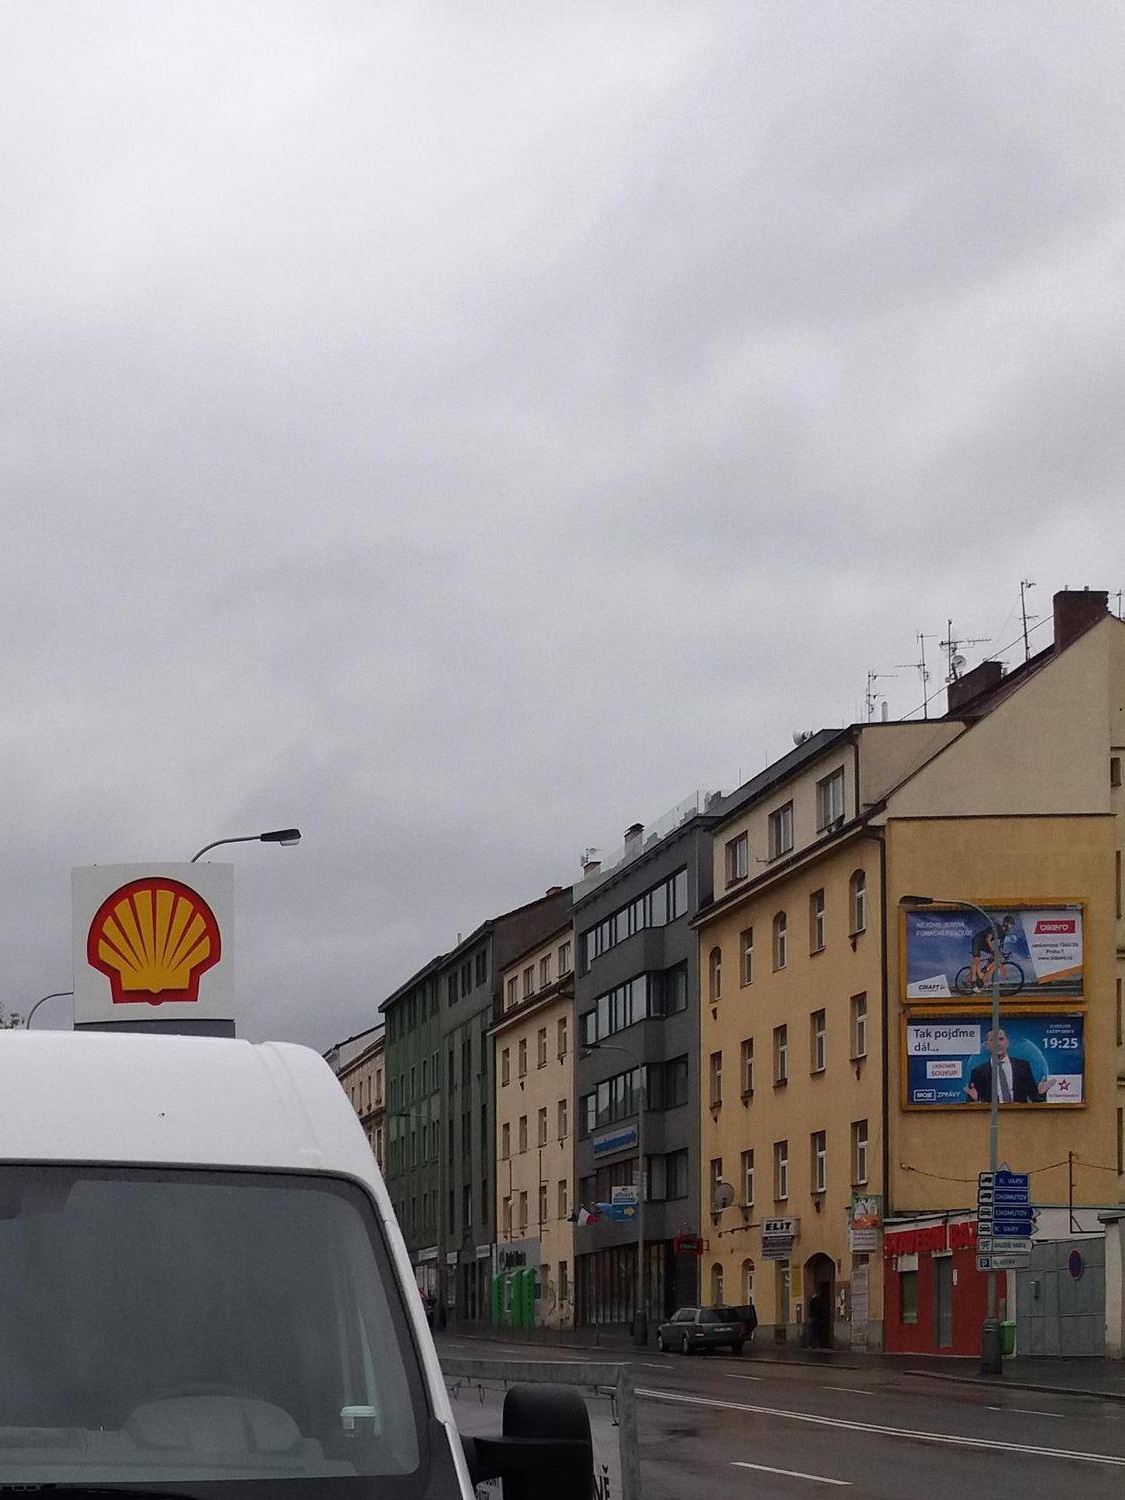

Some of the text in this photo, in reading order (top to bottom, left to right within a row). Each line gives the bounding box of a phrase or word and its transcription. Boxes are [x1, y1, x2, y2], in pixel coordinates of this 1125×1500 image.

[913, 1028, 975, 1040] Tak pojďme
[1042, 1037, 1079, 1049] 19:25
[765, 1221, 792, 1232] ELIT
